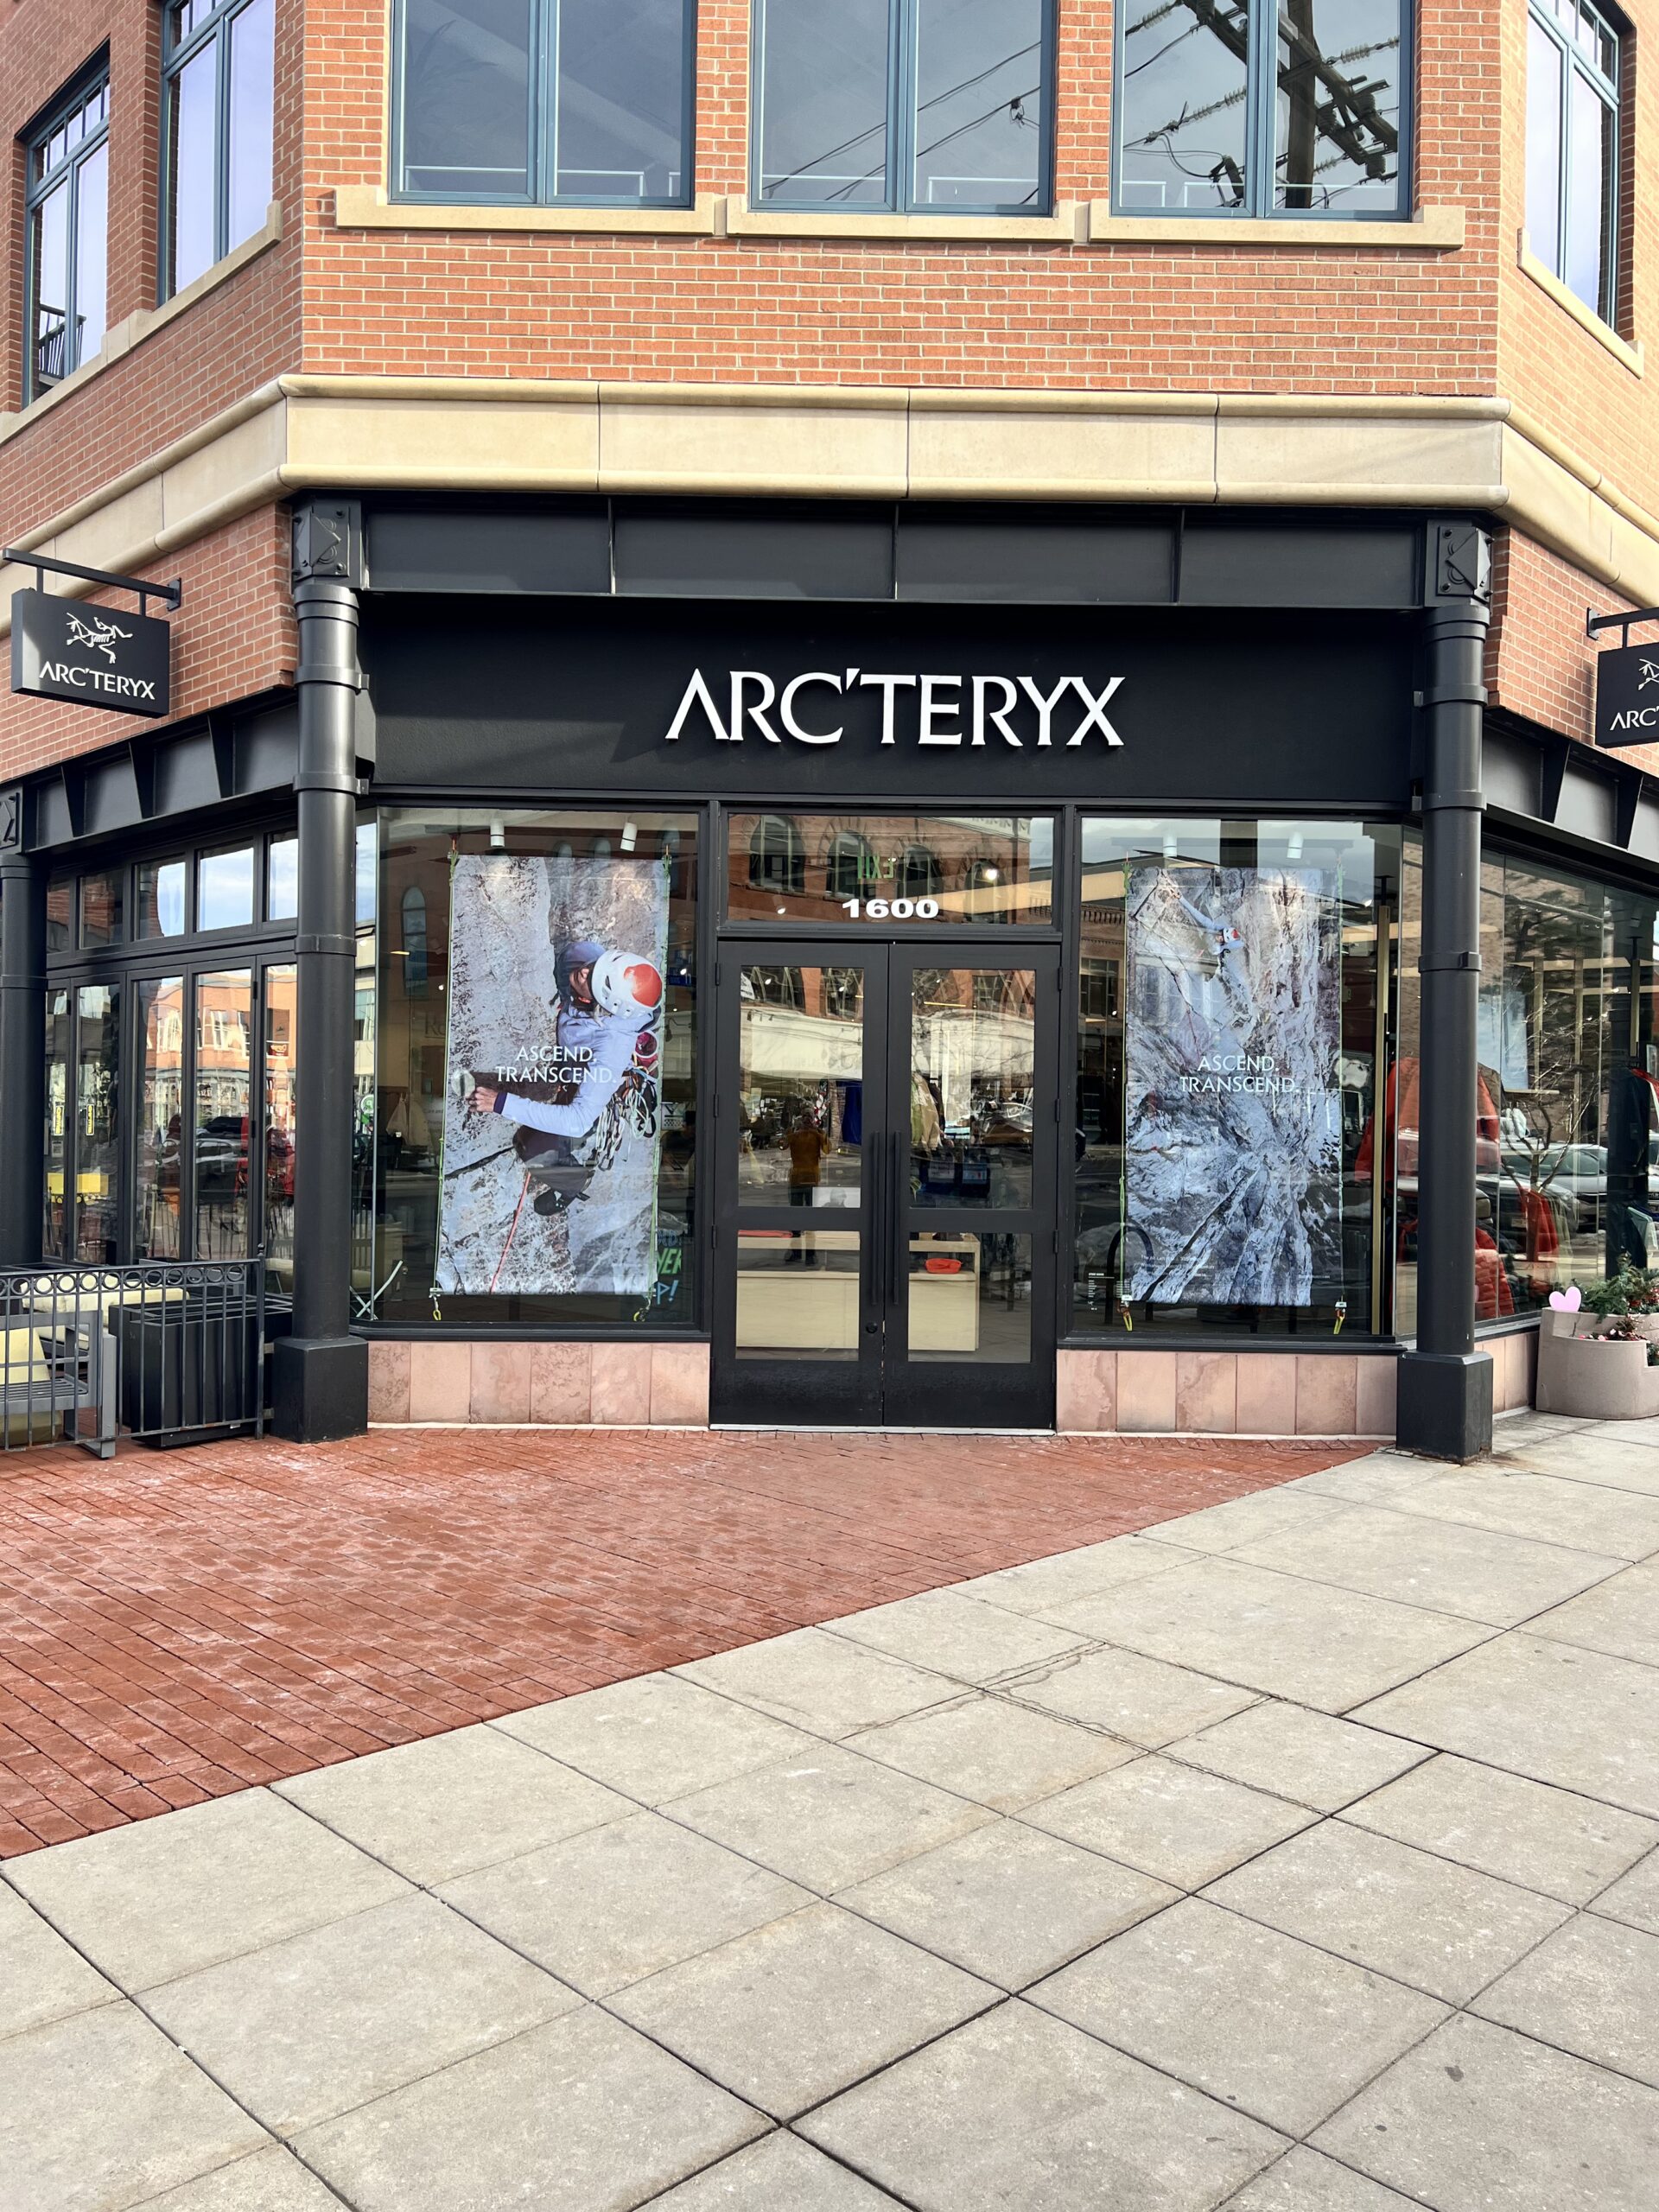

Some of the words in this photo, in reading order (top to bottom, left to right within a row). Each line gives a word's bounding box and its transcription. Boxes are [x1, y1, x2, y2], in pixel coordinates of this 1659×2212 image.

[39, 661, 156, 701] ARC'TERYX
[664, 668, 1126, 747] ARC'TERYX
[842, 899, 939, 918] 1600
[516, 1046, 597, 1063] ASCEND.
[1198, 1055, 1280, 1072] ASCEND.
[495, 1066, 617, 1084] TRANSCEND.
[1179, 1076, 1300, 1093] TRANSCEND.
